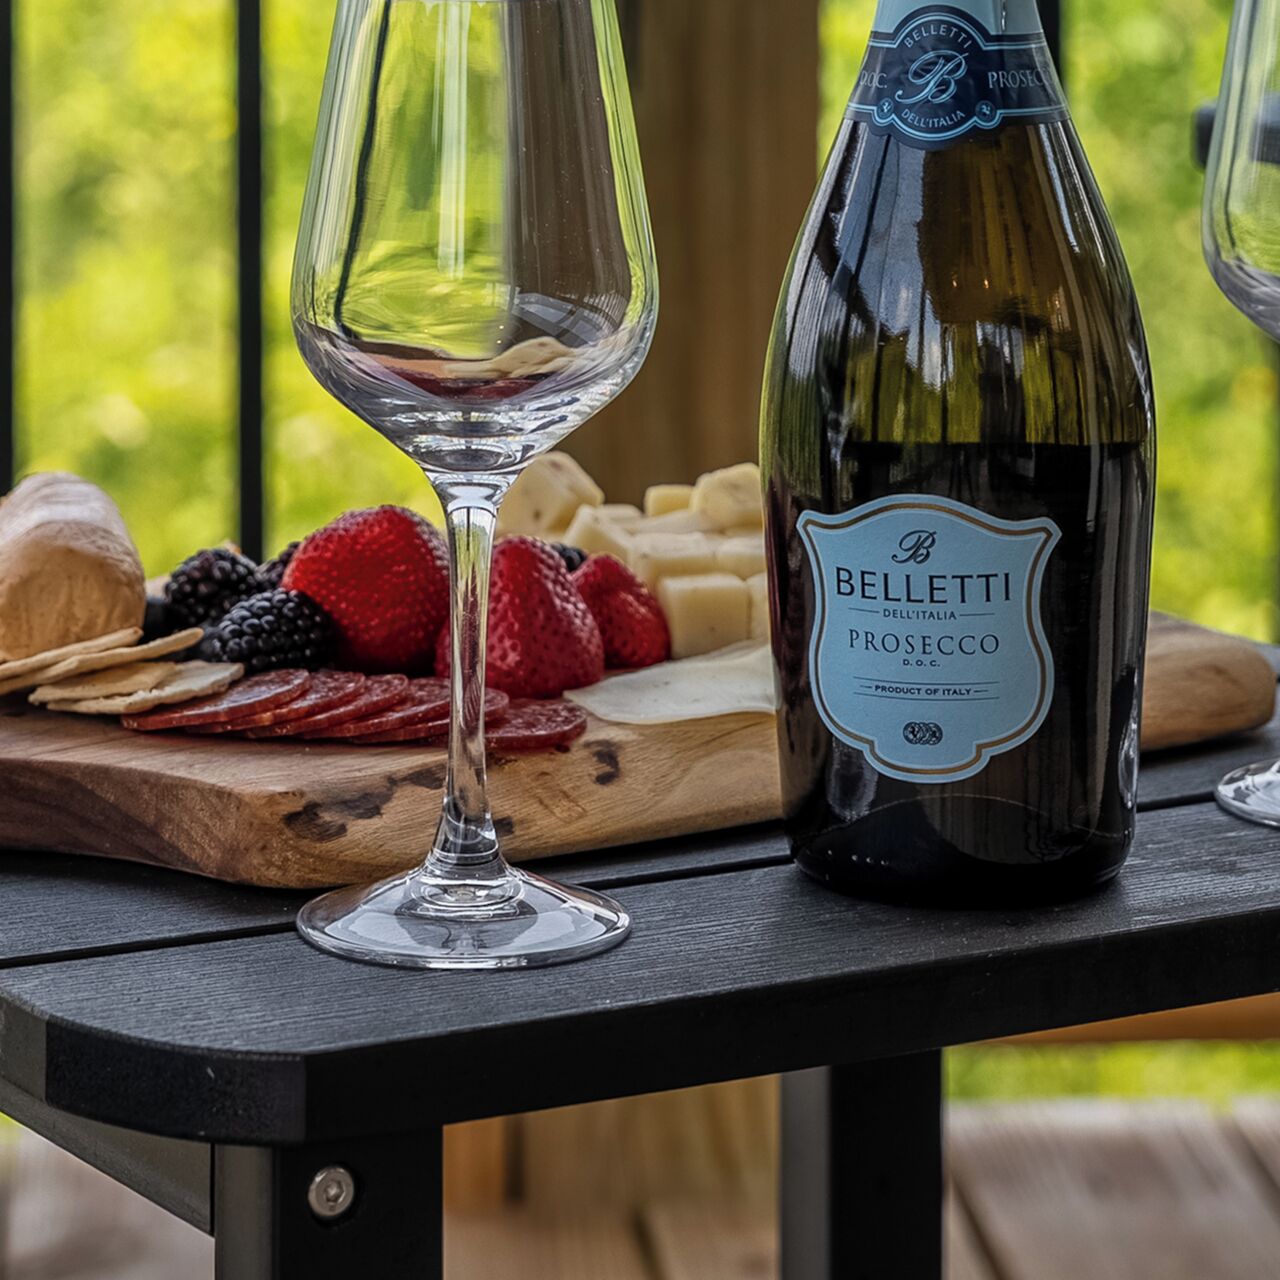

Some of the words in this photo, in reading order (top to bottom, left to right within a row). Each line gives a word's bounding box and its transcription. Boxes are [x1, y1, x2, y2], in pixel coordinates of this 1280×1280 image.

[904, 24, 972, 49] BELLETTI
[895, 50, 969, 104] B
[987, 69, 1047, 89] PROSEC
[901, 109, 966, 128] DELL'ITALIA
[891, 529, 937, 564] B
[835, 566, 1011, 604] BELLETTI
[883, 608, 957, 621] DELL'ITALIA
[848, 628, 1000, 656] PROSECCO
[874, 684, 922, 696] PRODUCT
[925, 687, 940, 696] OF
[942, 687, 972, 696] ITALY
